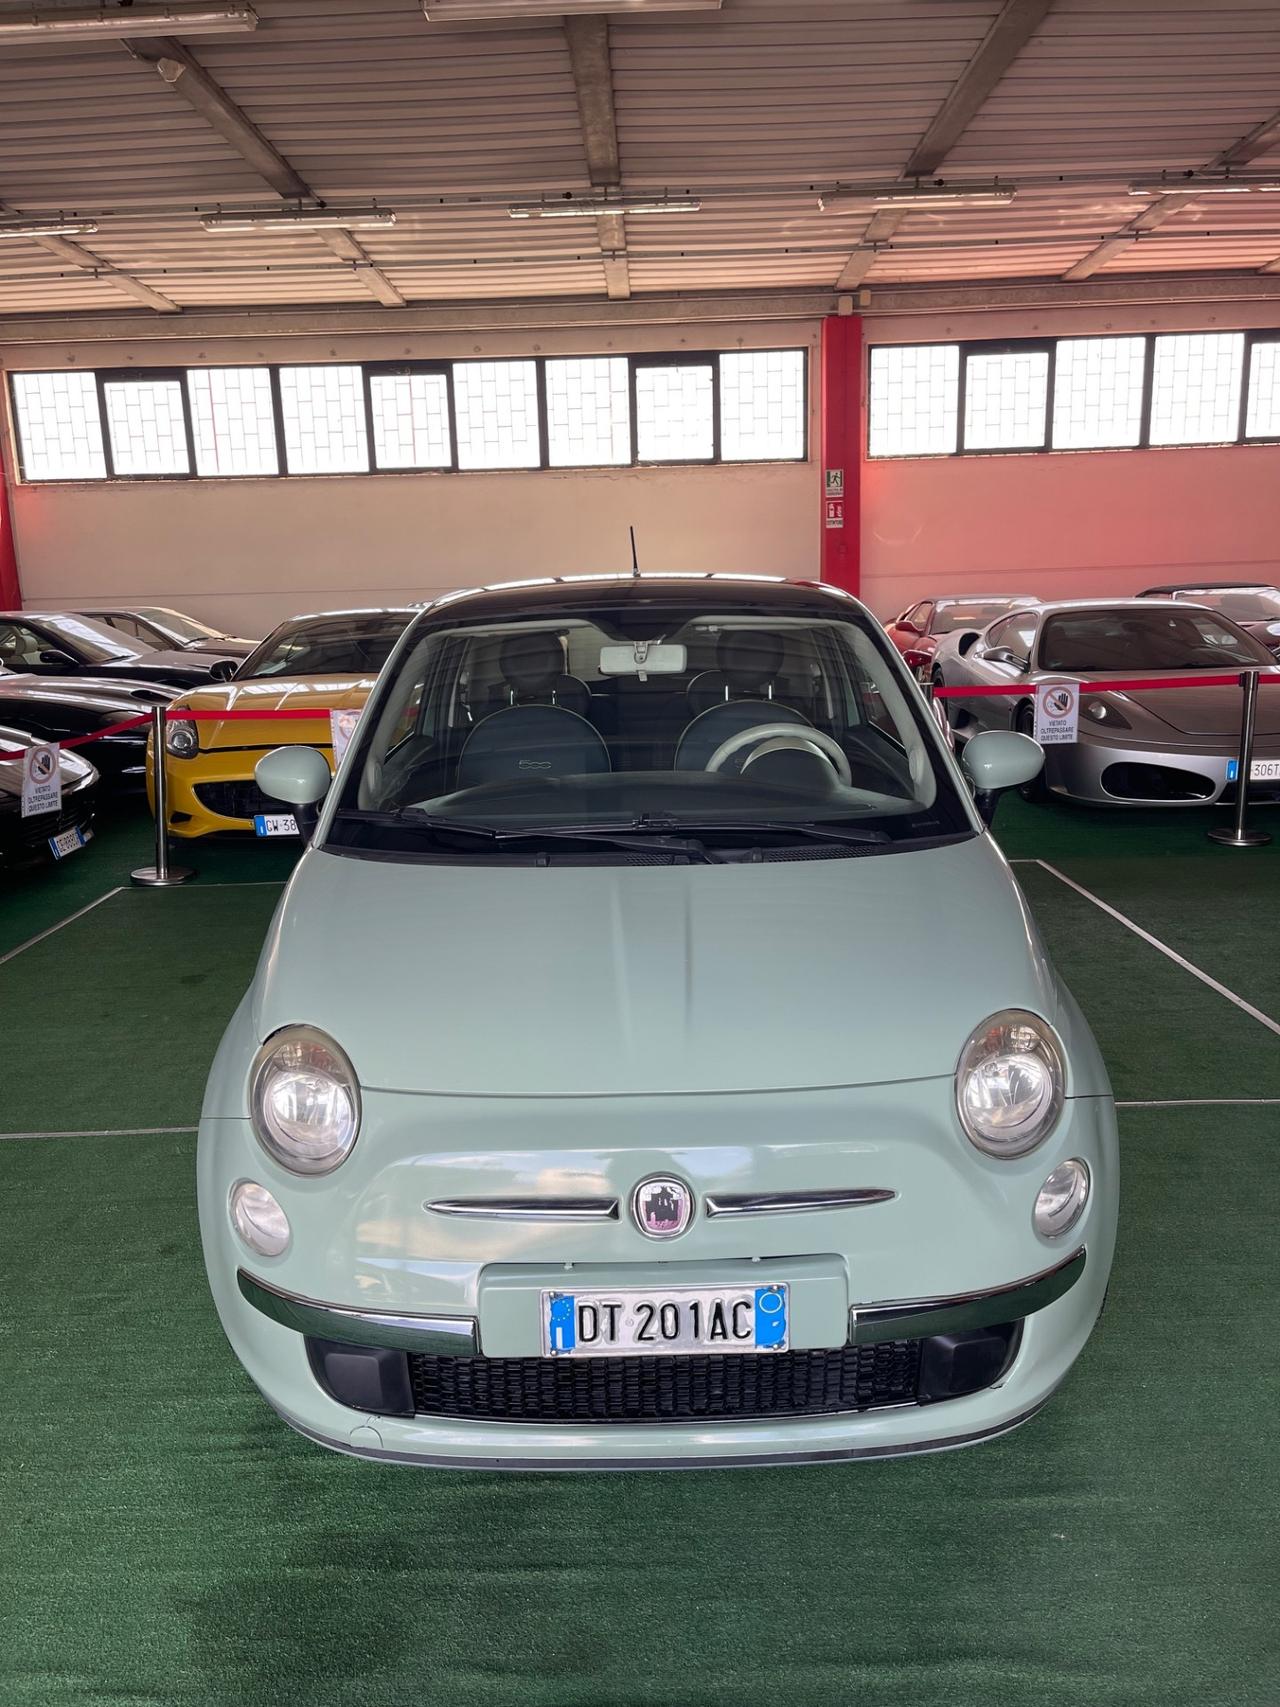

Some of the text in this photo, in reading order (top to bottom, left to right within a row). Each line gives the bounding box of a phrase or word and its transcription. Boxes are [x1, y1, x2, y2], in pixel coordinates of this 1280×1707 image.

[1254, 763, 1280, 777] 306T
[578, 1303, 623, 1343] DT
[636, 1300, 752, 1341] 201AC
